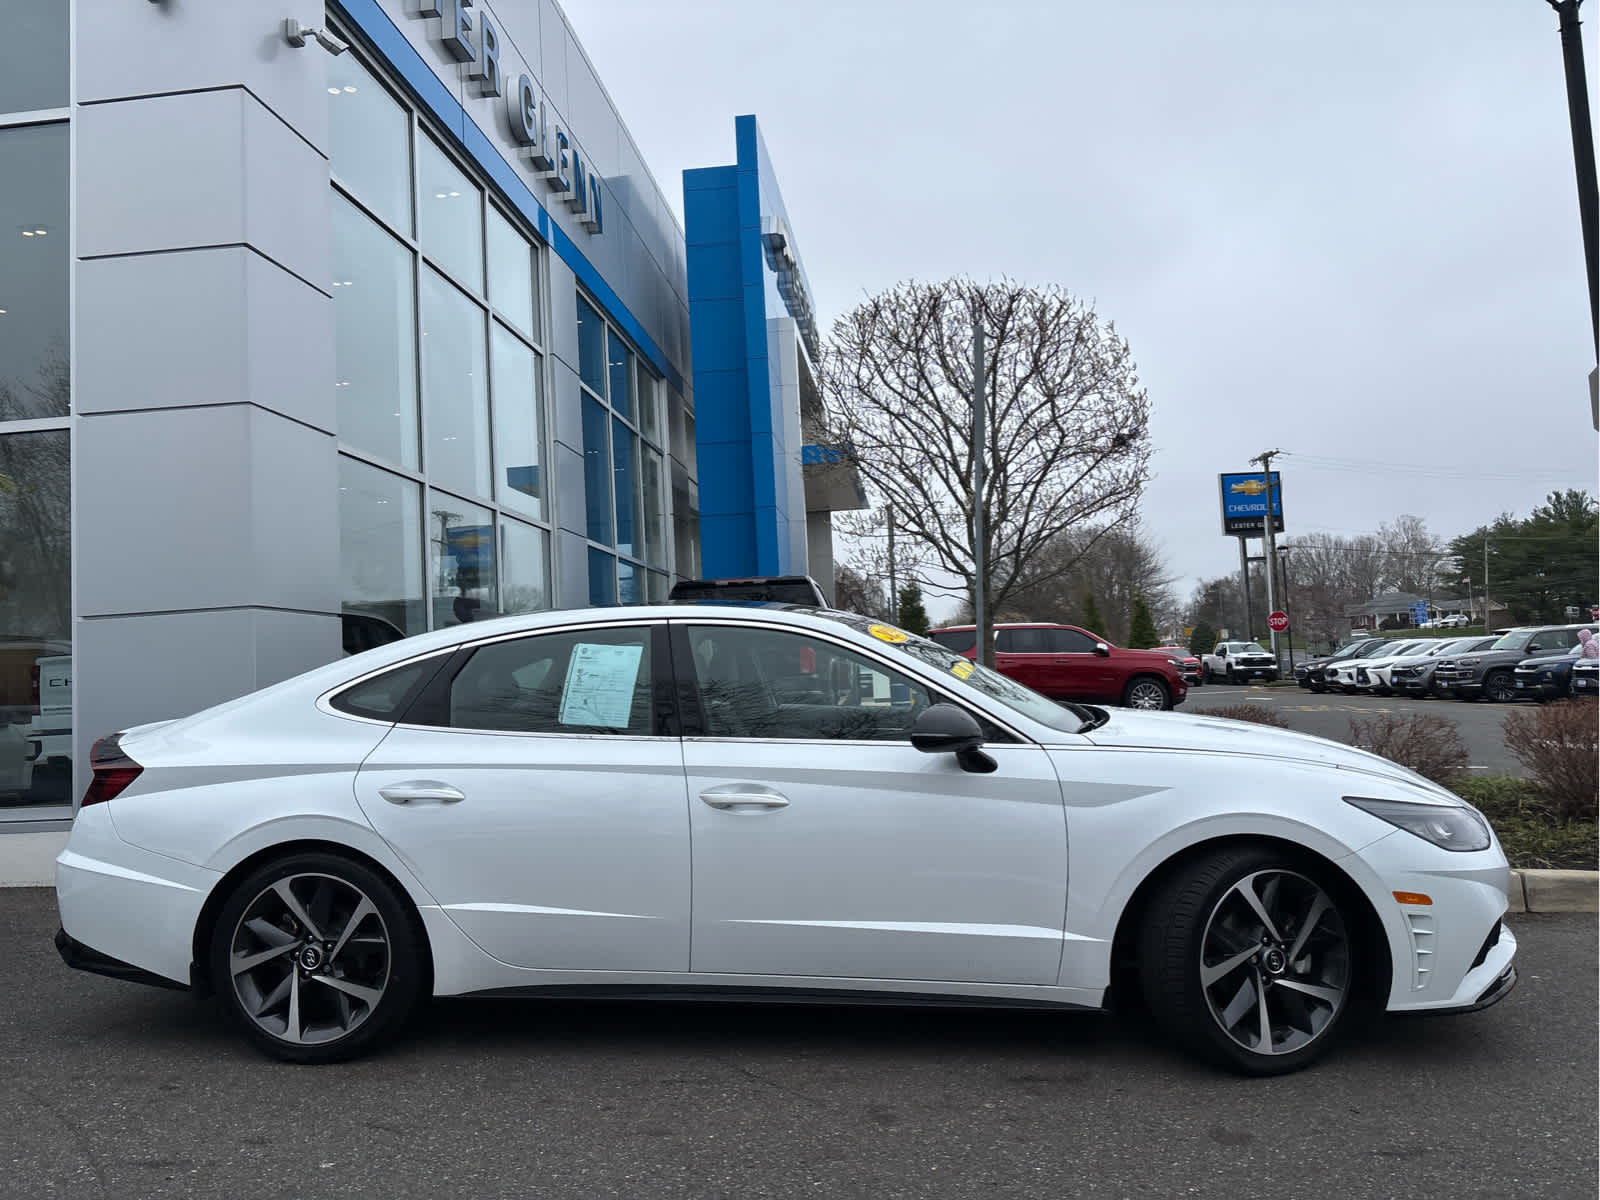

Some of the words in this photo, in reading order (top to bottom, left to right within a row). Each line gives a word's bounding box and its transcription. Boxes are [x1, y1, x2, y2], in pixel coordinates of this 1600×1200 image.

[506, 74, 603, 234] GLENN
[1228, 503, 1279, 513] CHEVROLT
[1231, 521, 1257, 529] LESTER
[1270, 617, 1288, 626] STOP
